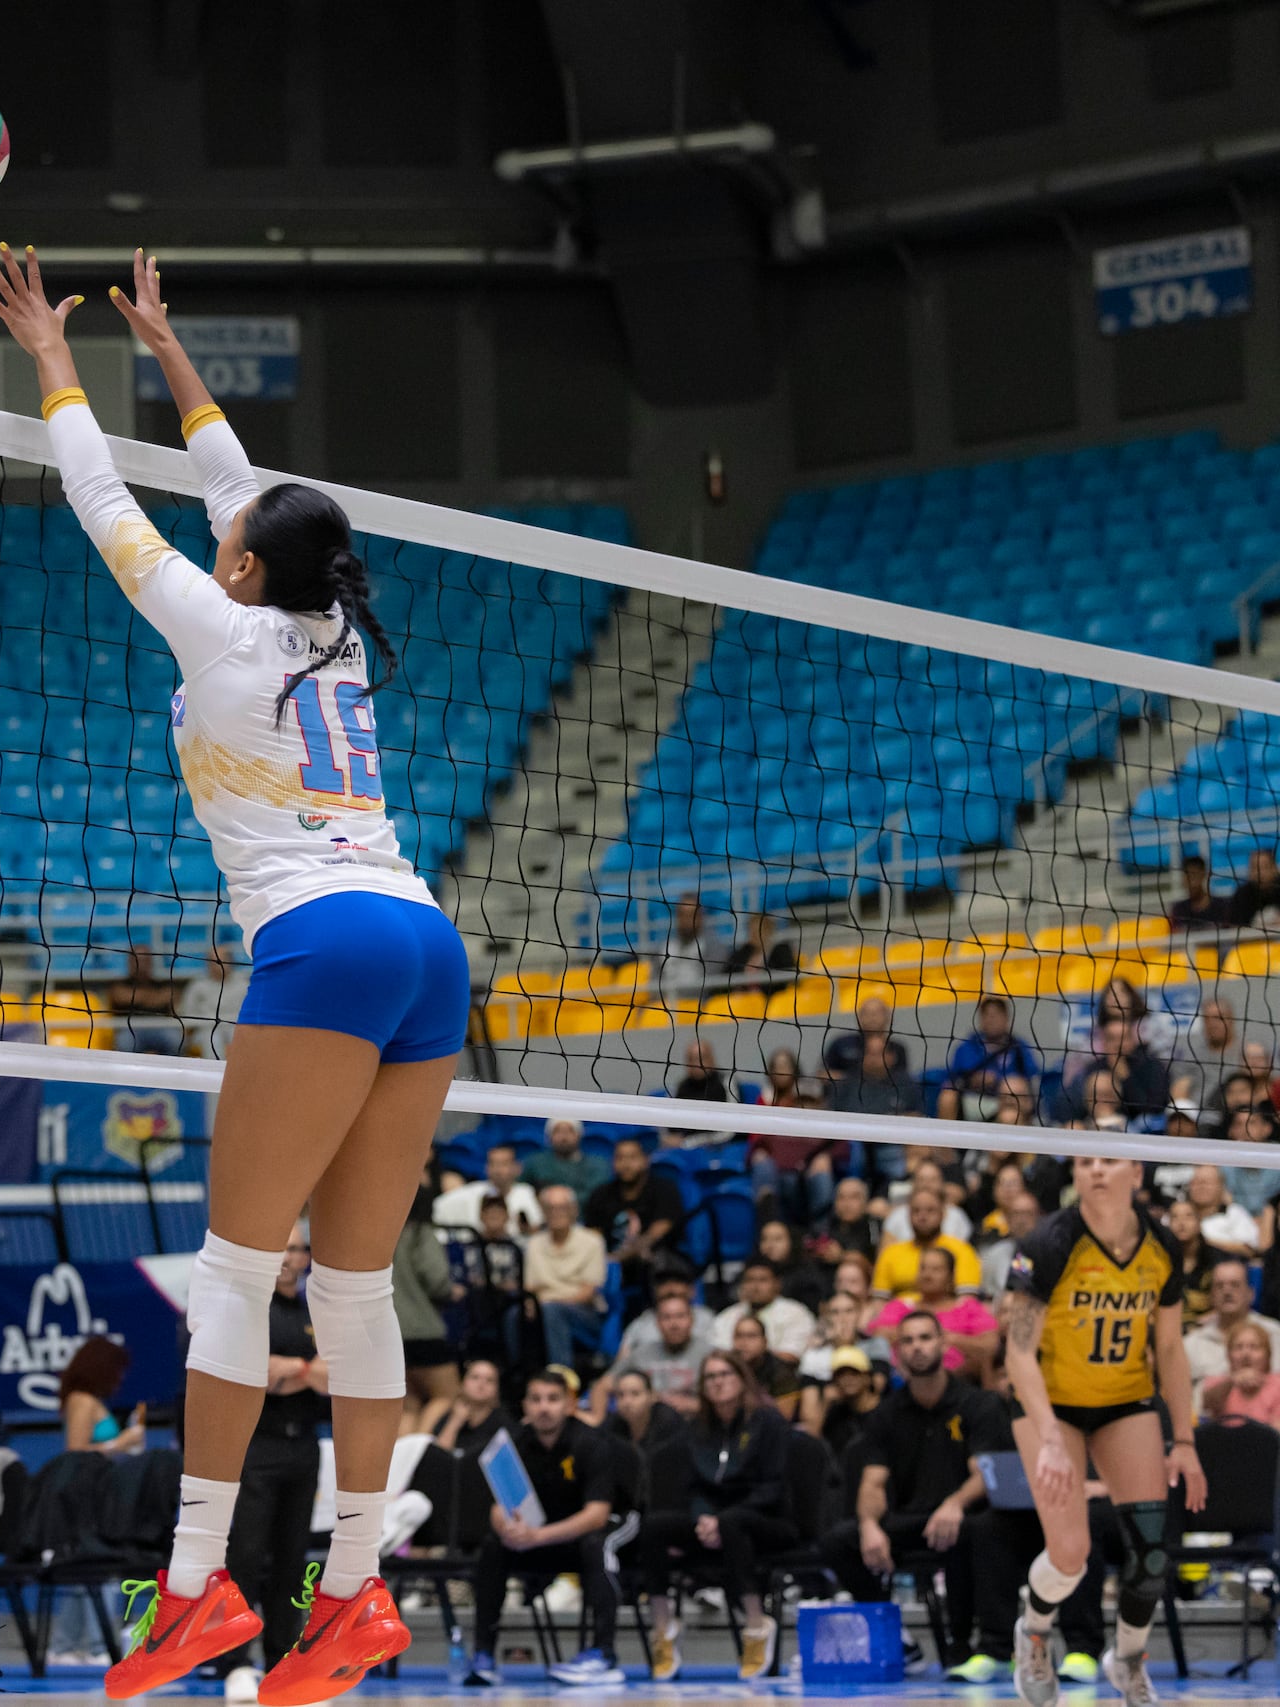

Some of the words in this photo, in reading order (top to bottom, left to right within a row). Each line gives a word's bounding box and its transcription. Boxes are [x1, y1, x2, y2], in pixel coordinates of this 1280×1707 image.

[1130, 276, 1217, 329] 304
[195, 358, 262, 397] 03
[1088, 1316, 1132, 1365] 15
